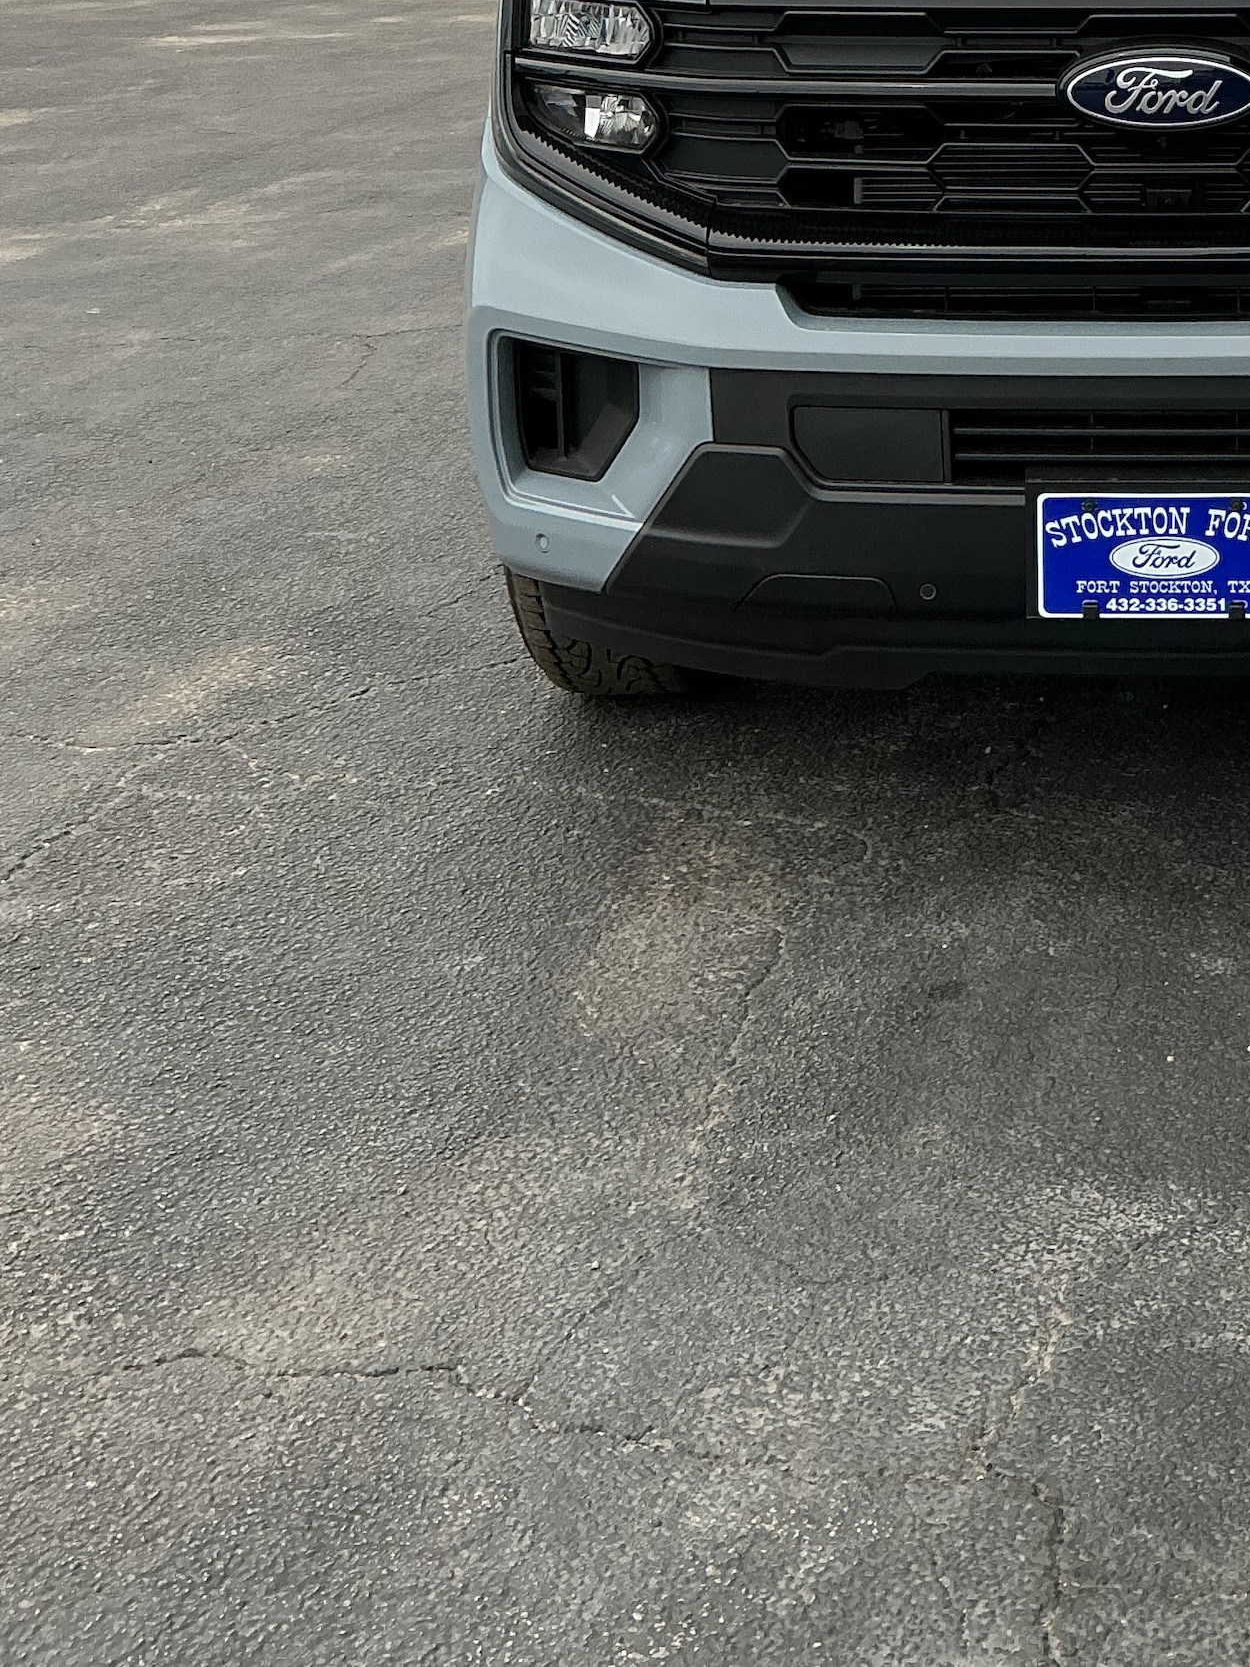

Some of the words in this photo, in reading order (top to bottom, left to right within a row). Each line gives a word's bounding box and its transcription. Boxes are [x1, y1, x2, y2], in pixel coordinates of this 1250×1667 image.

[1104, 65, 1220, 117] Ford
[1045, 507, 1191, 548] STOCKTON
[1131, 543, 1197, 570] Ford
[1076, 580, 1120, 594] FORT
[1129, 580, 1218, 595] STOCKTON,
[1106, 598, 1226, 612] 432-336-3351
